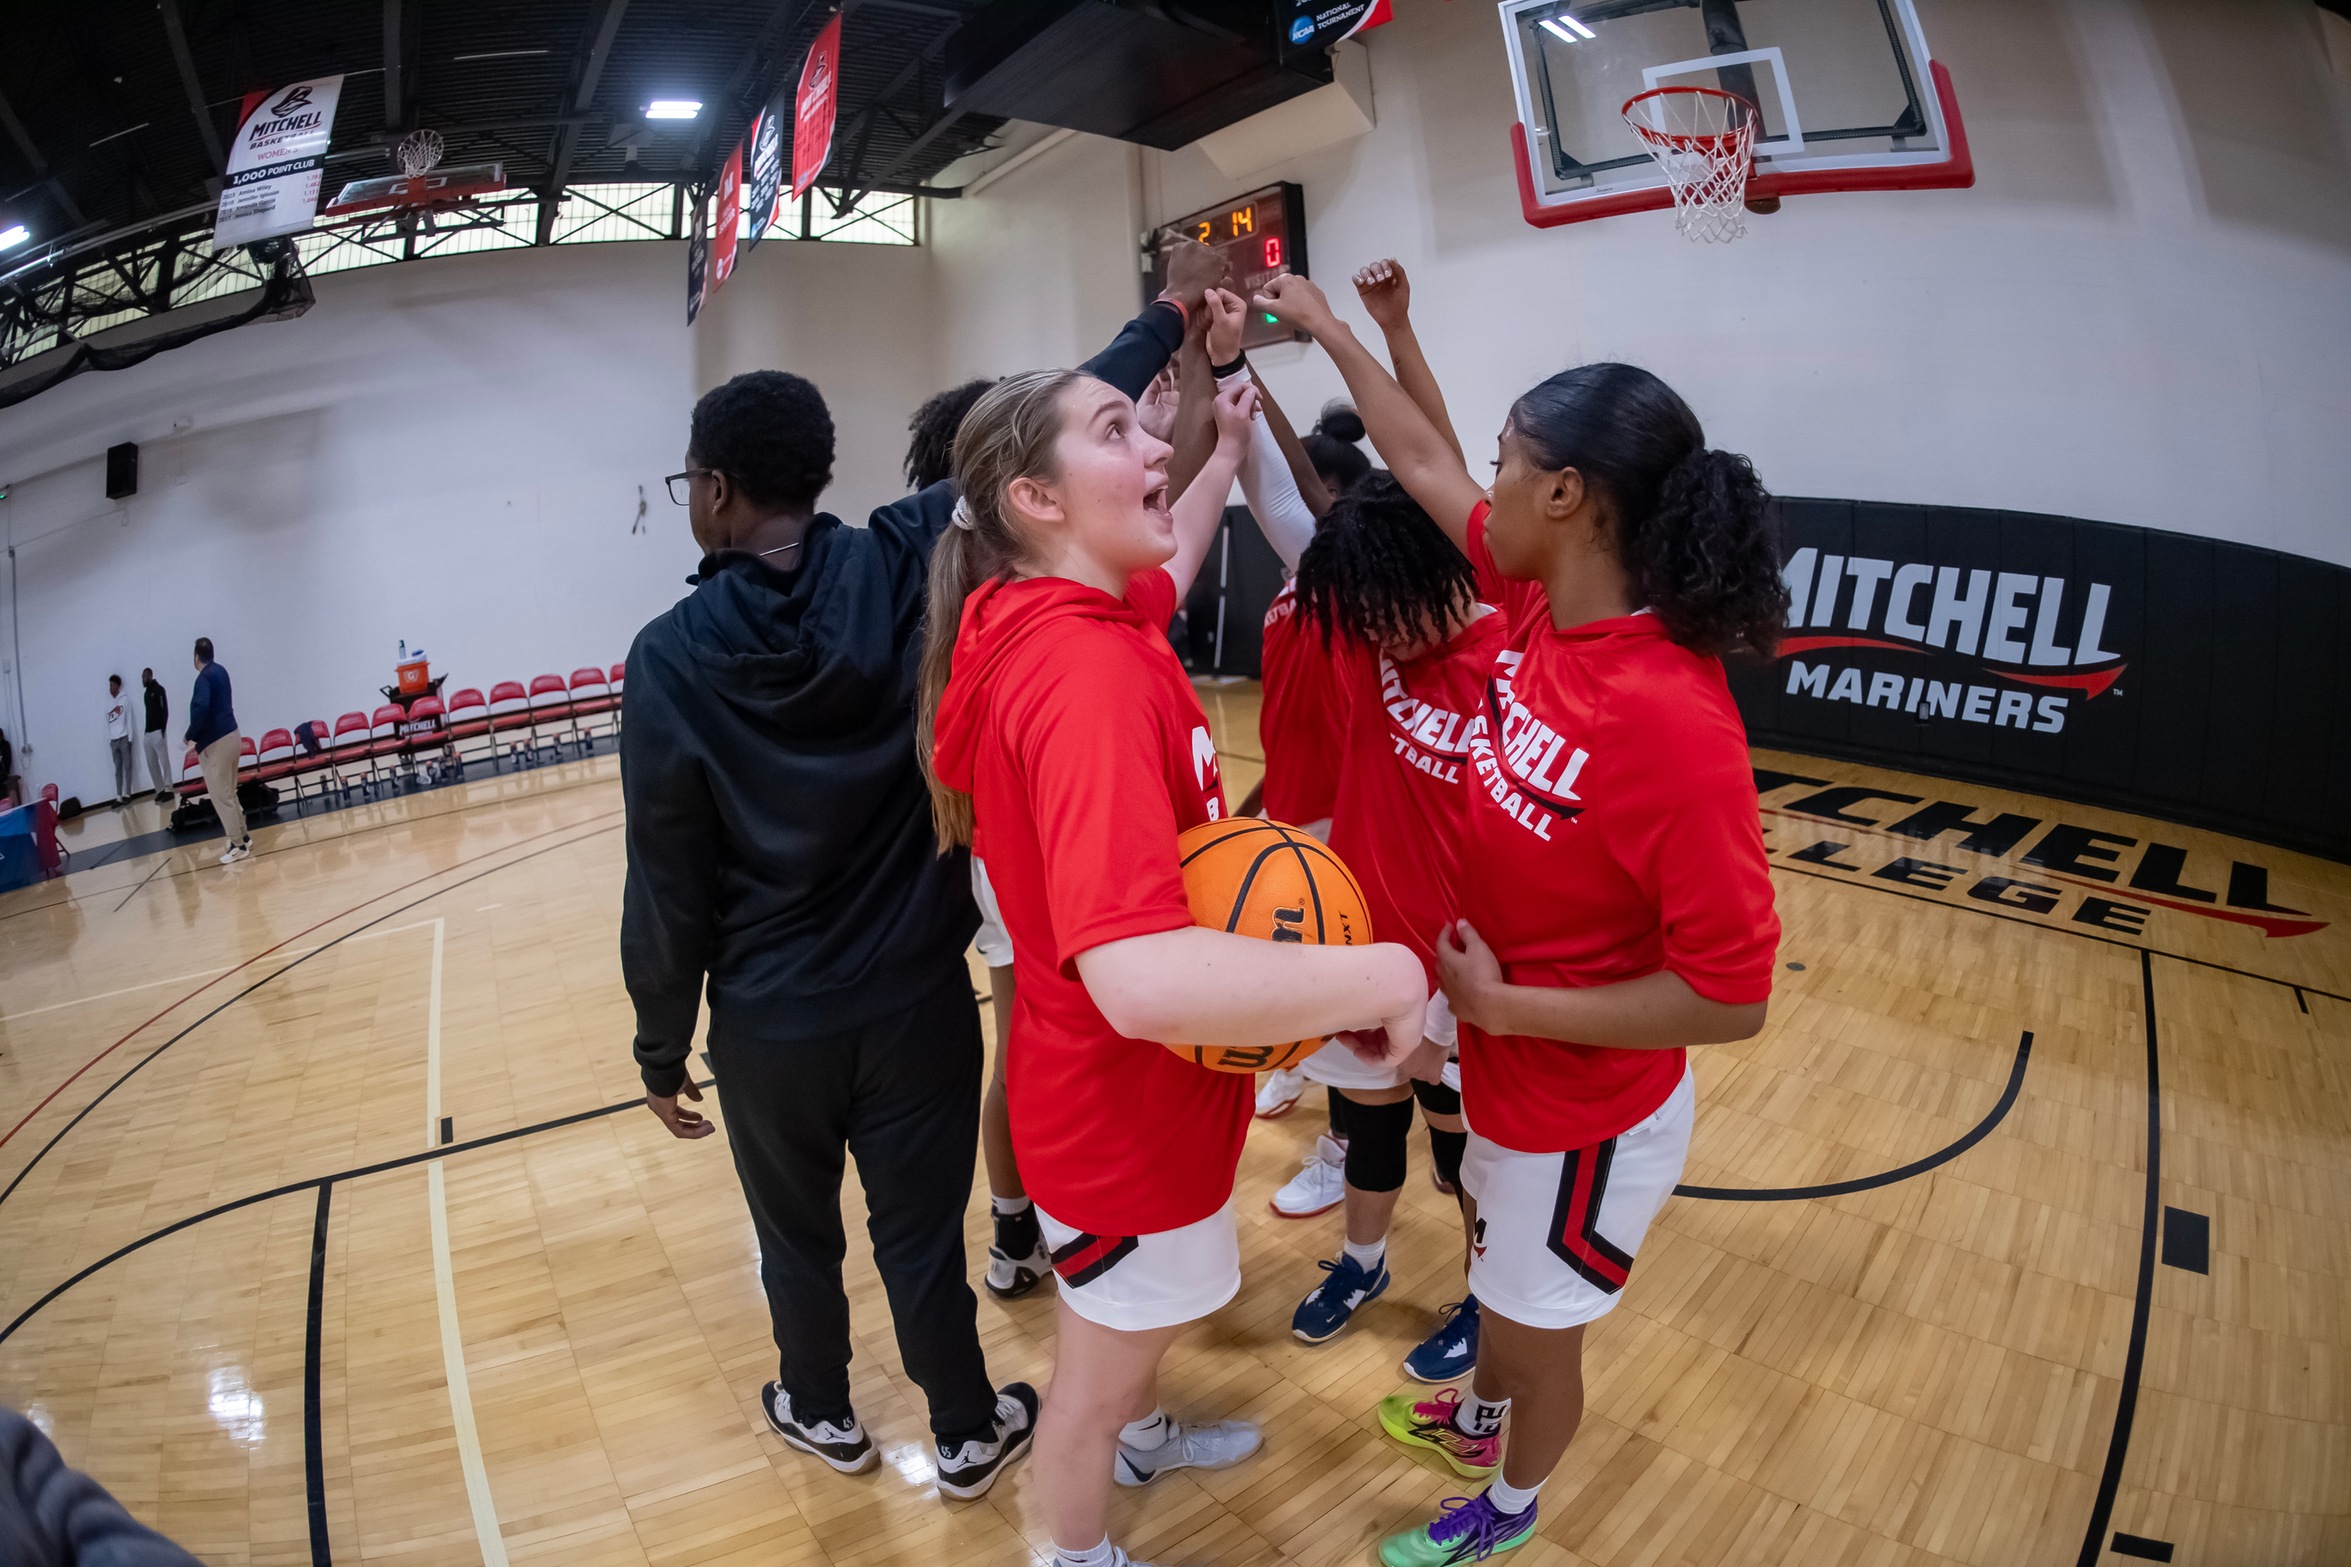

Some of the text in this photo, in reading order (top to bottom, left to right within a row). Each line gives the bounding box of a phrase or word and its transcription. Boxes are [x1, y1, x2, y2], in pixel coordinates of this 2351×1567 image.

[1316, 2, 1351, 21] NATIONAL
[1317, 4, 1365, 29] TOURNAMENT
[248, 111, 322, 142] MITCHELL
[233, 159, 315, 185] 1,000 POINT CLUB
[1264, 238, 1281, 268] 0
[1786, 660, 2069, 734] MARINERS
